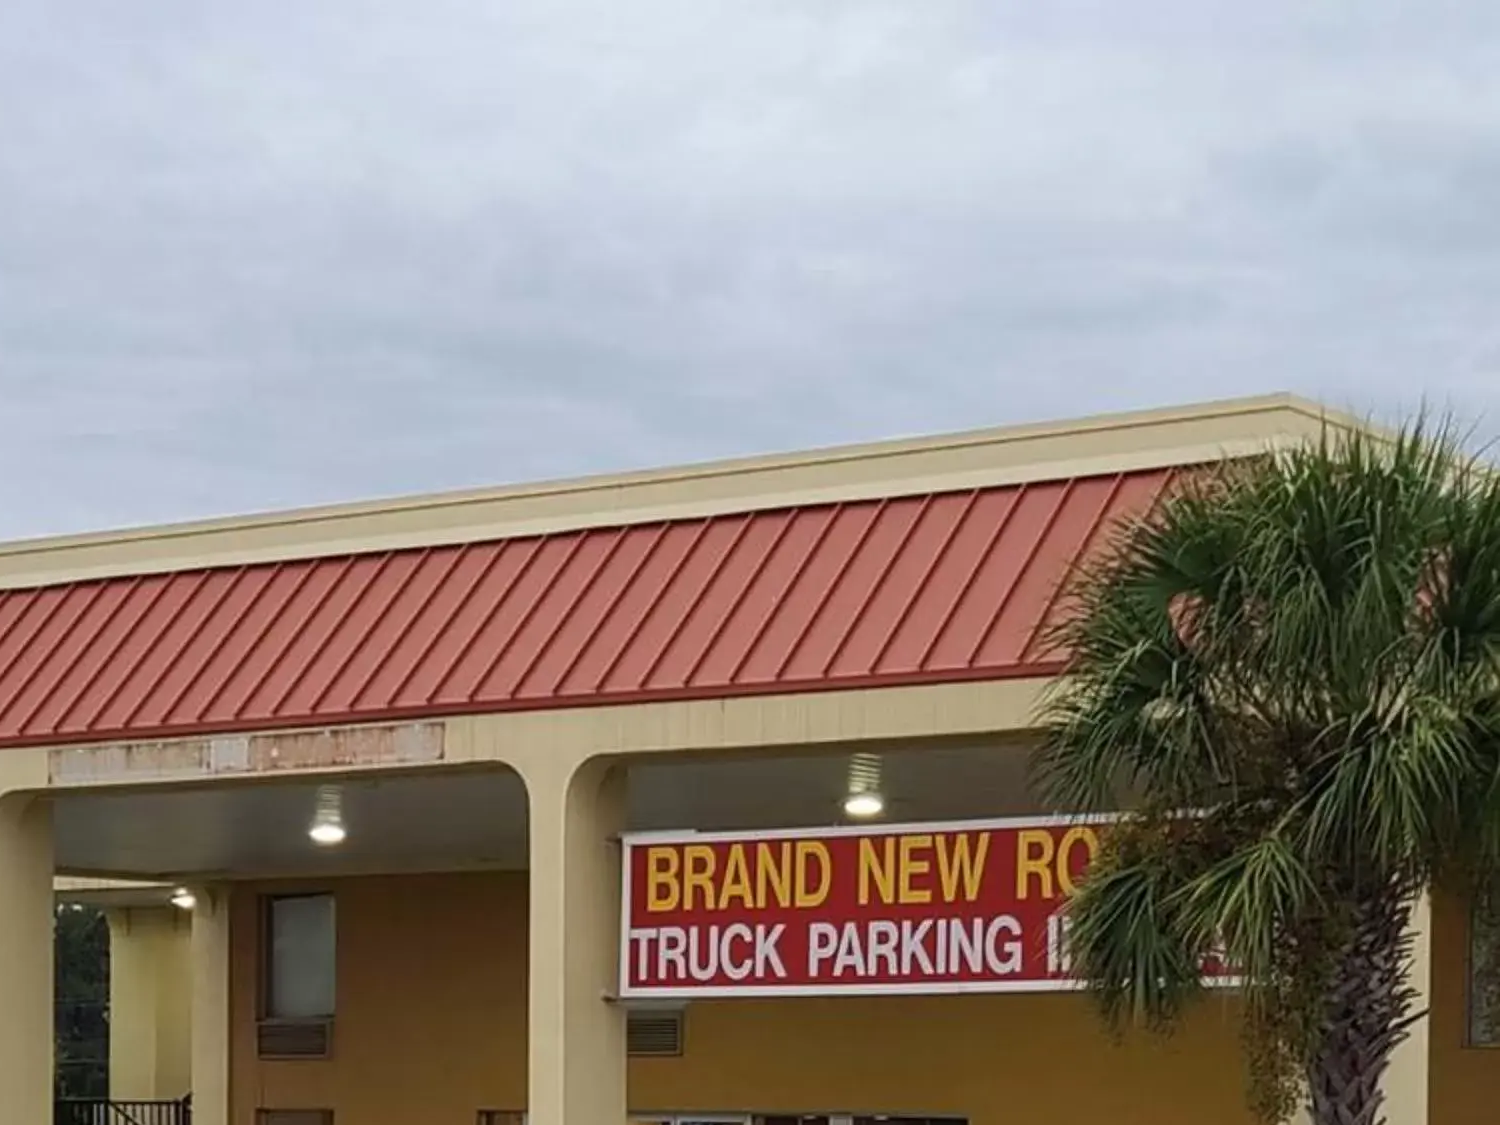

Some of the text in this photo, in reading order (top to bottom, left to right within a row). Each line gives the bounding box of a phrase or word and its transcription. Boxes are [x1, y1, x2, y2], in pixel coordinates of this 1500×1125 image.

[646, 840, 832, 913] BRAND
[857, 831, 991, 905] NEW
[630, 921, 788, 982] TRUCK
[806, 914, 1024, 978] PARKING
